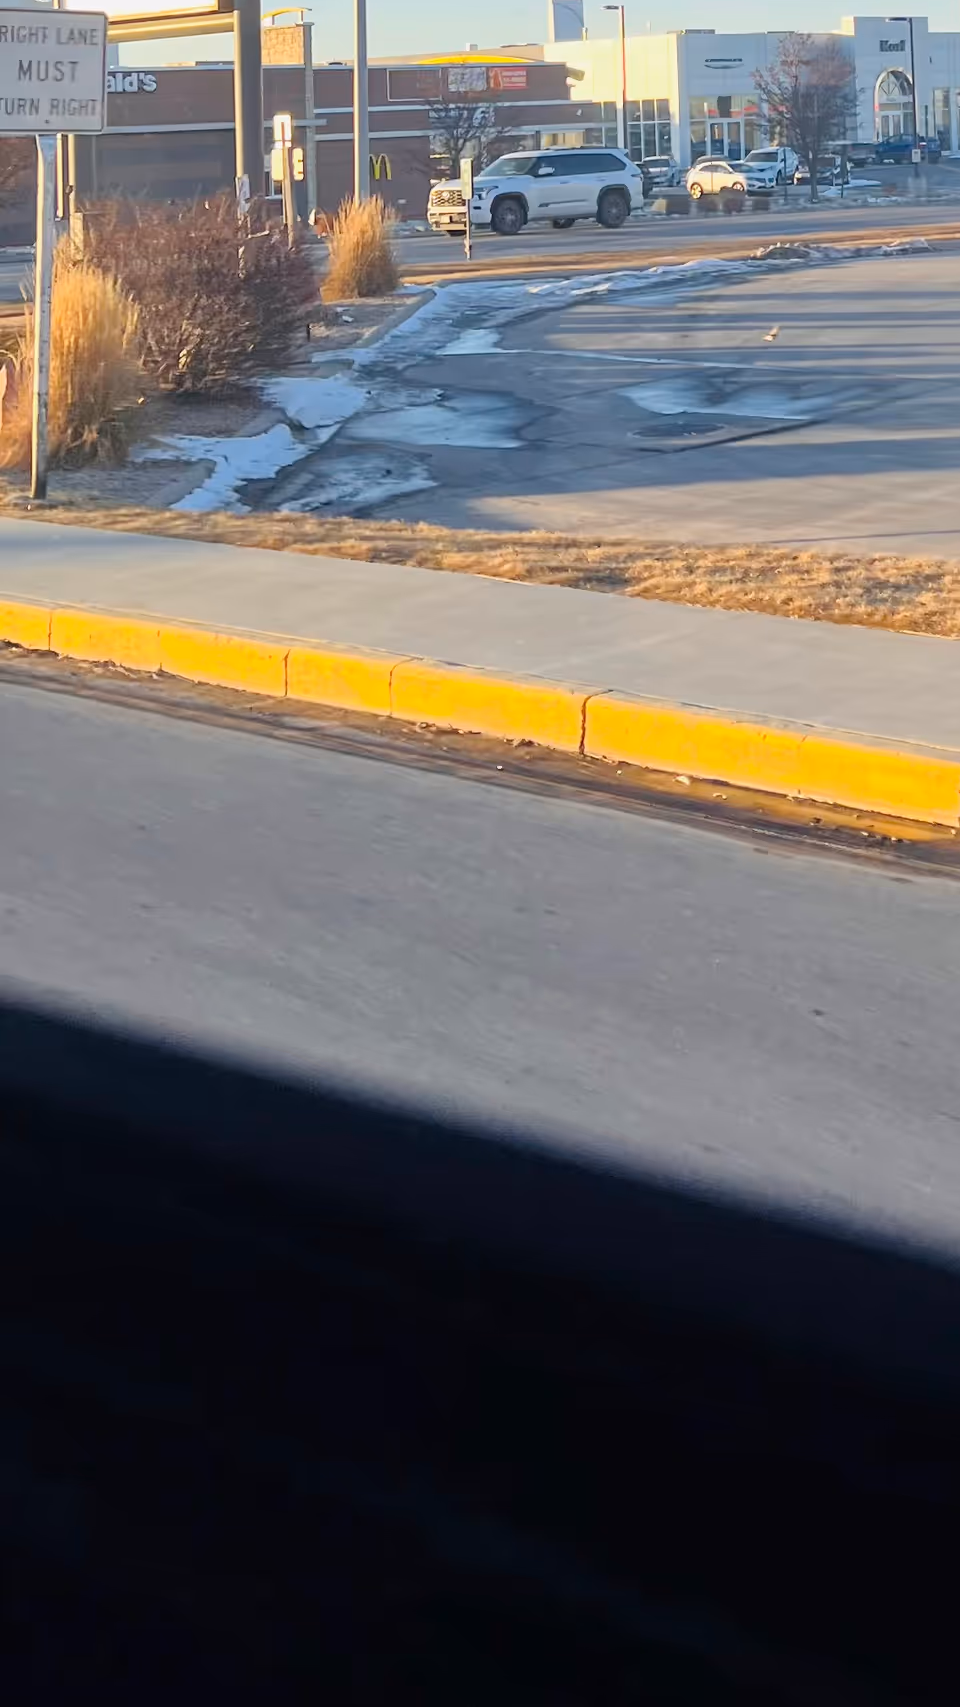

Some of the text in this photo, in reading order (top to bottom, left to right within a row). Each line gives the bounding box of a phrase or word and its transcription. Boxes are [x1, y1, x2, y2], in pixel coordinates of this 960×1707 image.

[0, 25, 98, 45] RIGHT LANE
[18, 59, 79, 82] MUST
[107, 72, 157, 93] ald's
[49, 98, 98, 116] RIGHT
